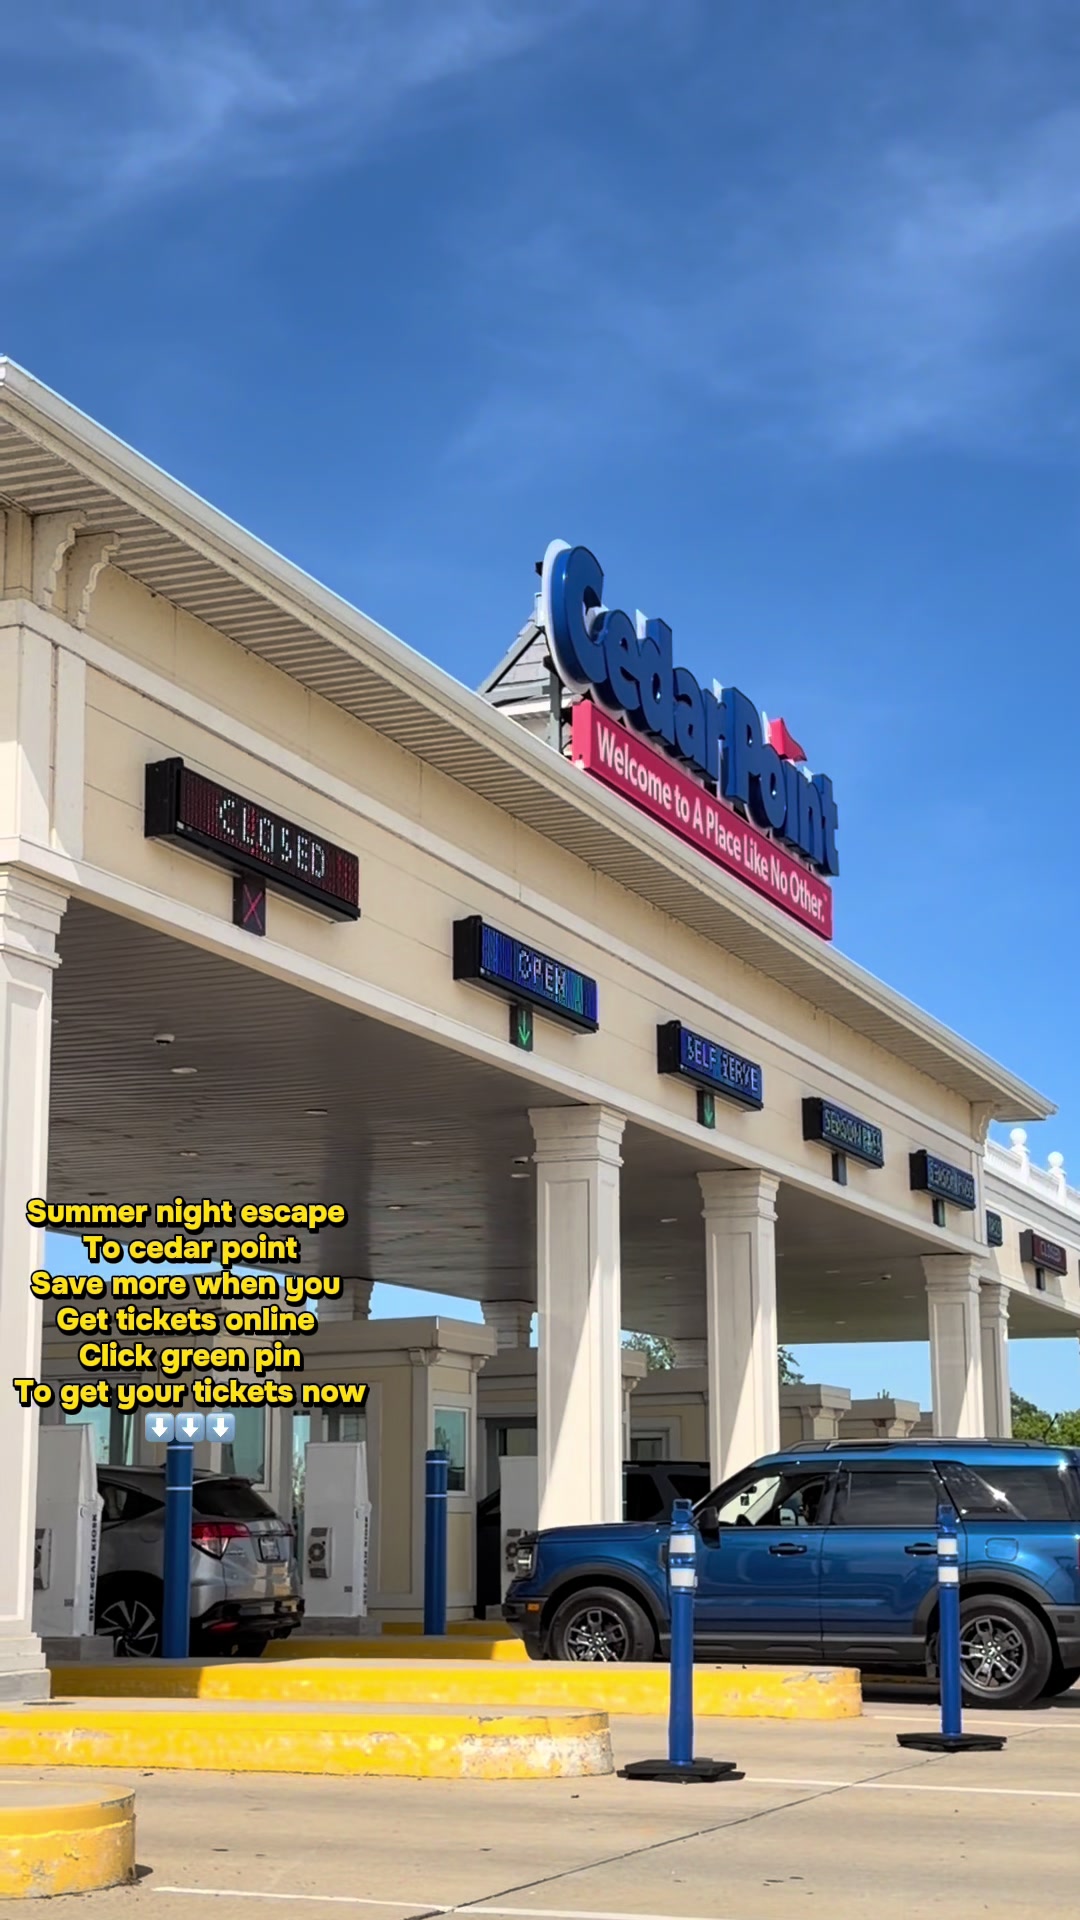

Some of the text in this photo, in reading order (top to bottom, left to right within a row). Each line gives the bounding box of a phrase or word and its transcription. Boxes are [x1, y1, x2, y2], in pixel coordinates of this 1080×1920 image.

[543, 541, 727, 782] Cedar
[218, 798, 326, 879] CLOSED
[597, 720, 672, 811] Welcome
[674, 784, 690, 824] to
[692, 796, 704, 835] A
[705, 804, 742, 862] Place
[743, 833, 769, 881] Like
[770, 854, 788, 896] No
[720, 686, 839, 876] Point
[518, 949, 567, 994] OPEN
[687, 1035, 717, 1070] SELF
